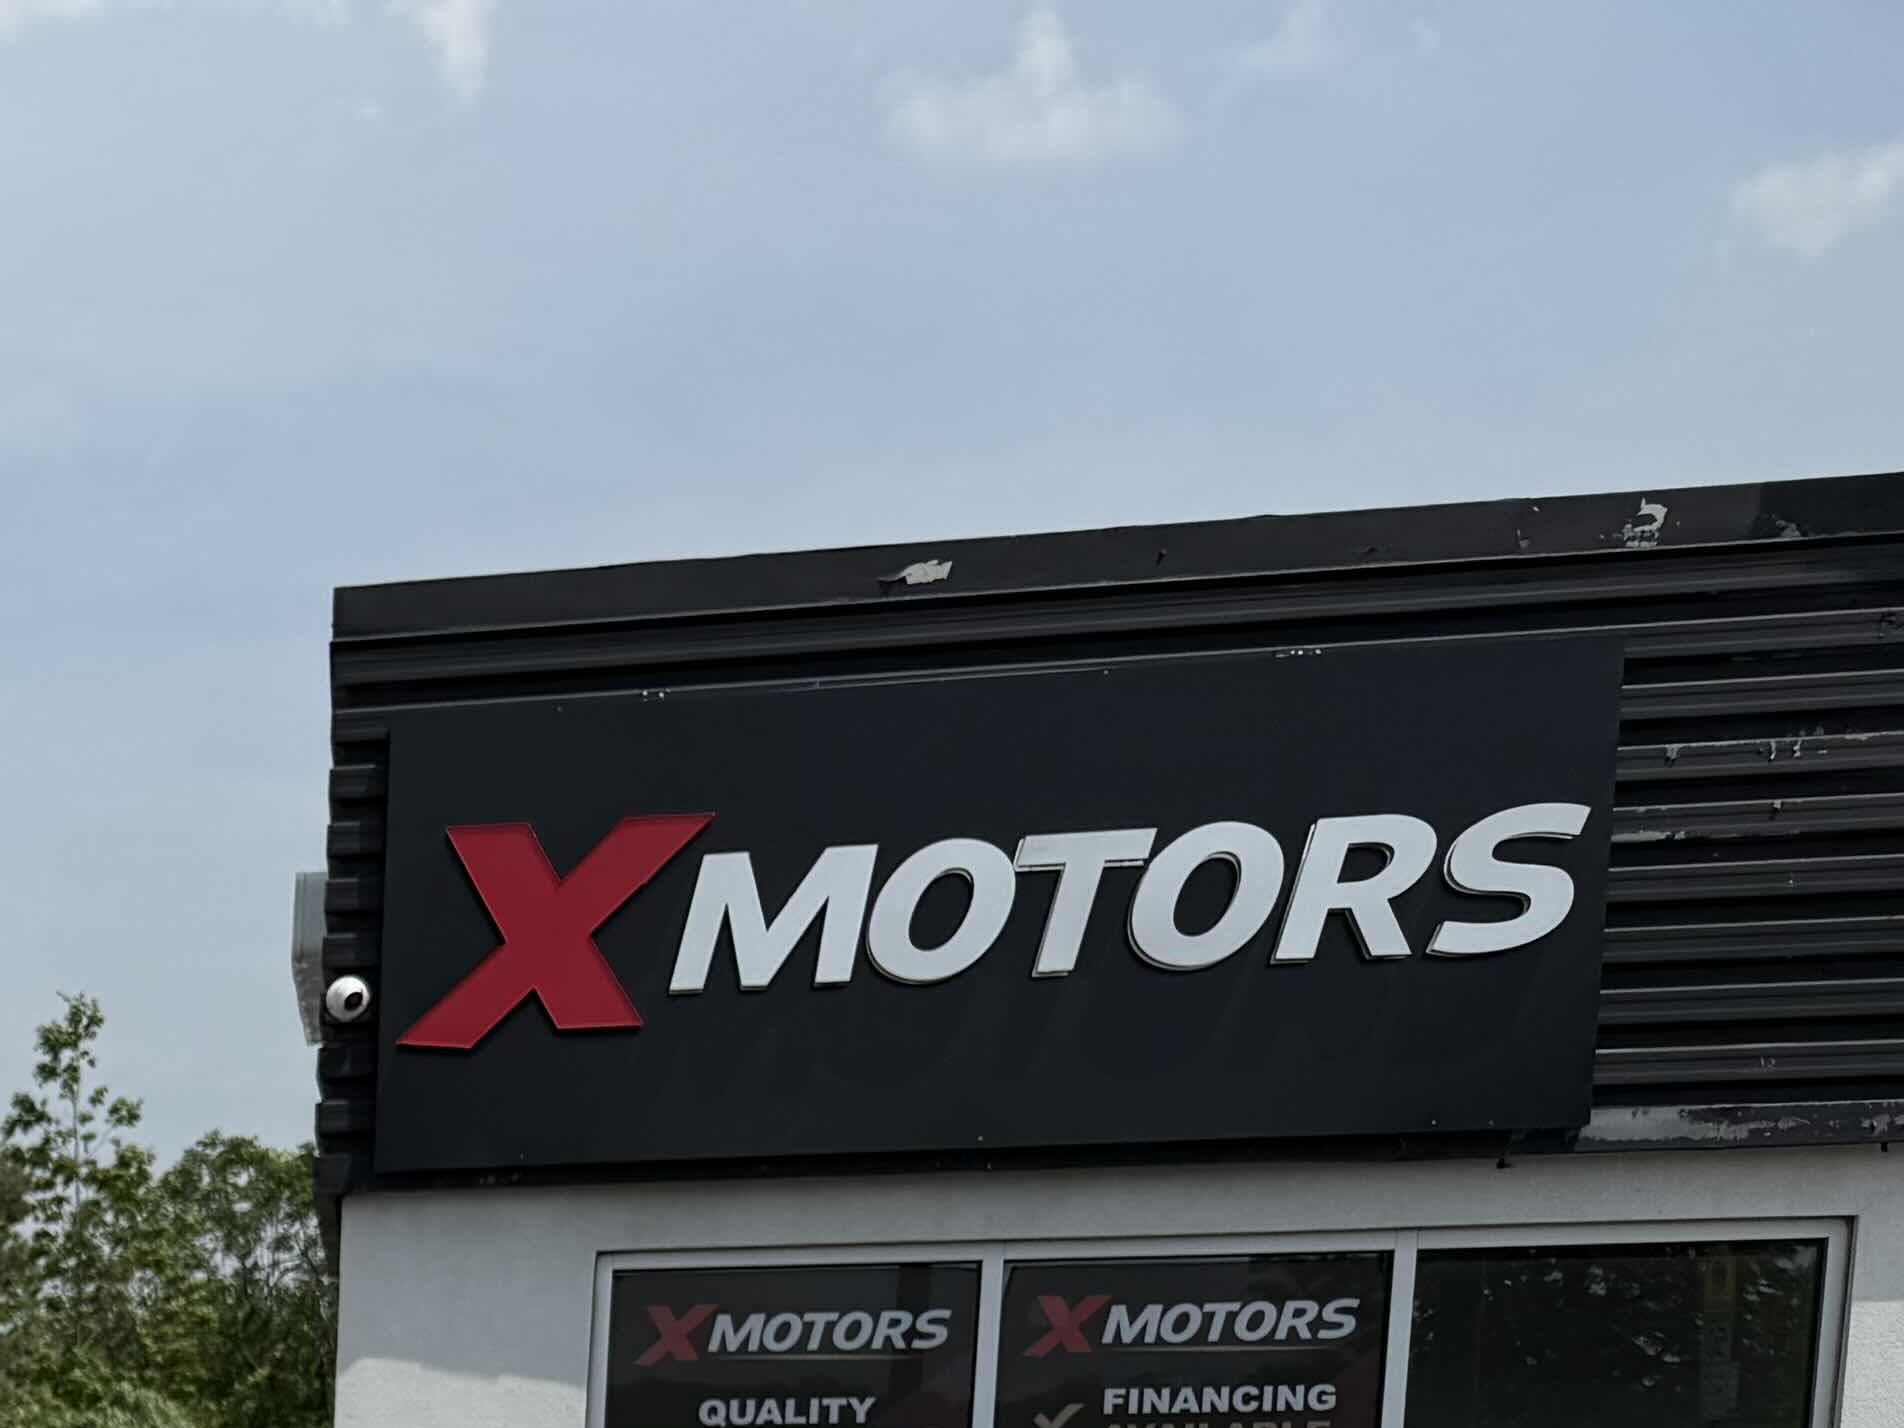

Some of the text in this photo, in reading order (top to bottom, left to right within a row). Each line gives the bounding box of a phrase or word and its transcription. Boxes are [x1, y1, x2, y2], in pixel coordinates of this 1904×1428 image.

[396, 801, 1592, 1049] X MOTORS
[632, 1304, 952, 1366] X MOTORS
[1024, 1295, 1361, 1357] X MOTORS
[698, 1397, 876, 1427] QUALITY
[1103, 1384, 1337, 1415] FINANCING
